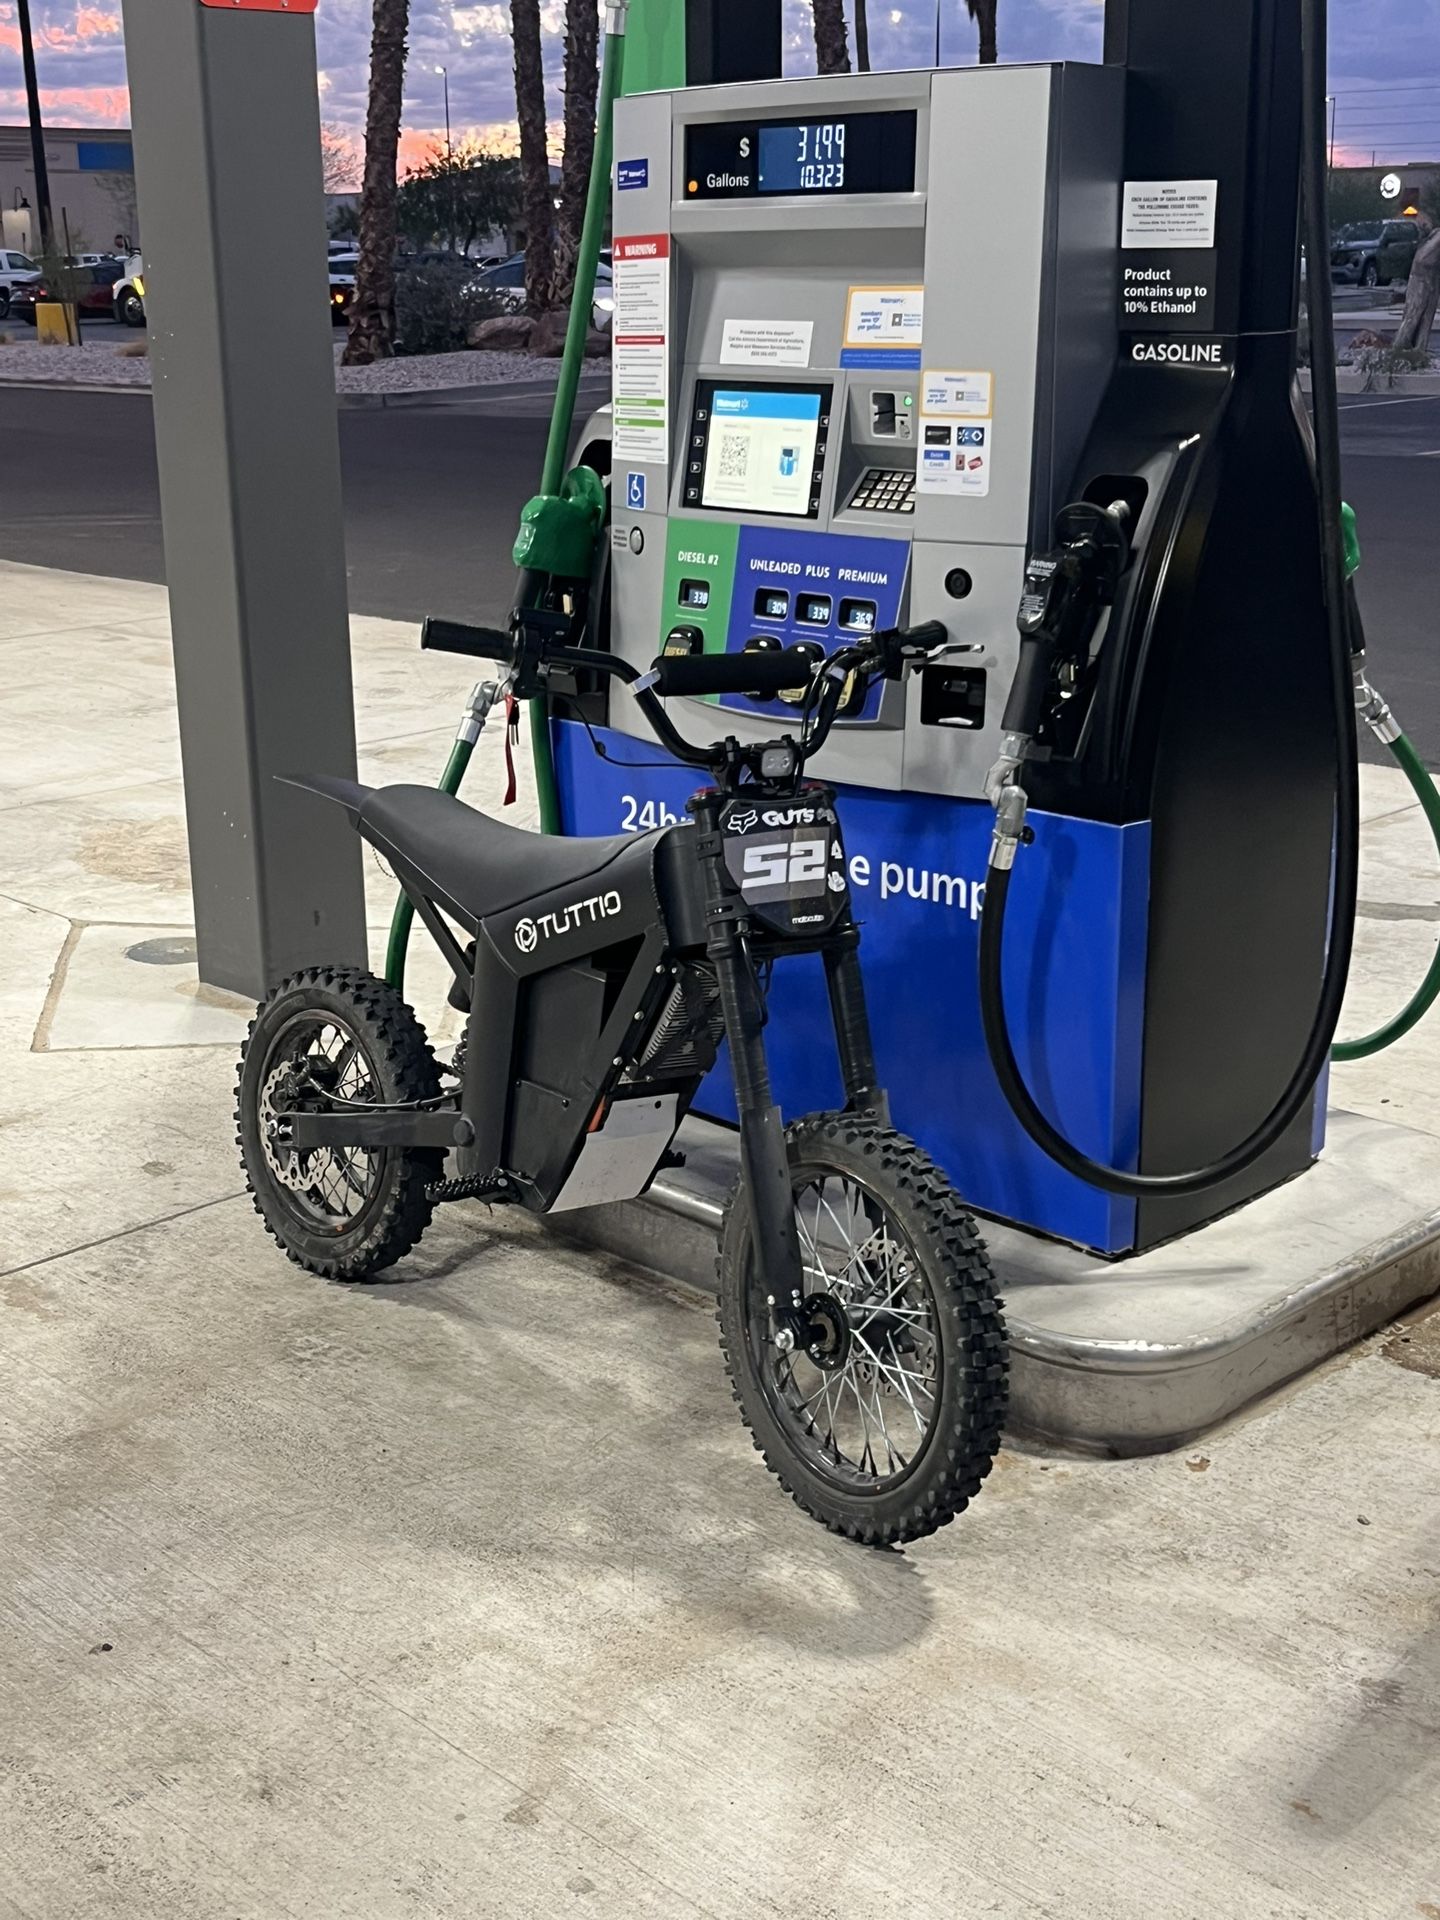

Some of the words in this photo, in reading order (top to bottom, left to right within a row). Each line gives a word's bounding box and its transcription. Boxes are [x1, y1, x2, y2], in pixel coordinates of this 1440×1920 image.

[739, 137, 750, 158] $
[706, 173, 750, 188] Gallons
[1124, 268, 1171, 281] Product
[1124, 285, 1174, 297] contains
[1176, 287, 1192, 300] up
[1194, 285, 1208, 297] to
[1124, 301, 1149, 314] 10%
[1151, 301, 1197, 314] Ethanol
[1132, 343, 1222, 363] GASOLINE
[677, 551, 706, 564] DIESEL
[708, 554, 719, 566] #2
[750, 559, 801, 575] UNLEADED
[805, 565, 831, 578] PLUS
[838, 568, 888, 585] PREMIUM
[621, 795, 694, 832] 24h
[762, 808, 815, 827] GUTS
[742, 839, 826, 889] 52
[536, 890, 622, 939] TUTTIO
